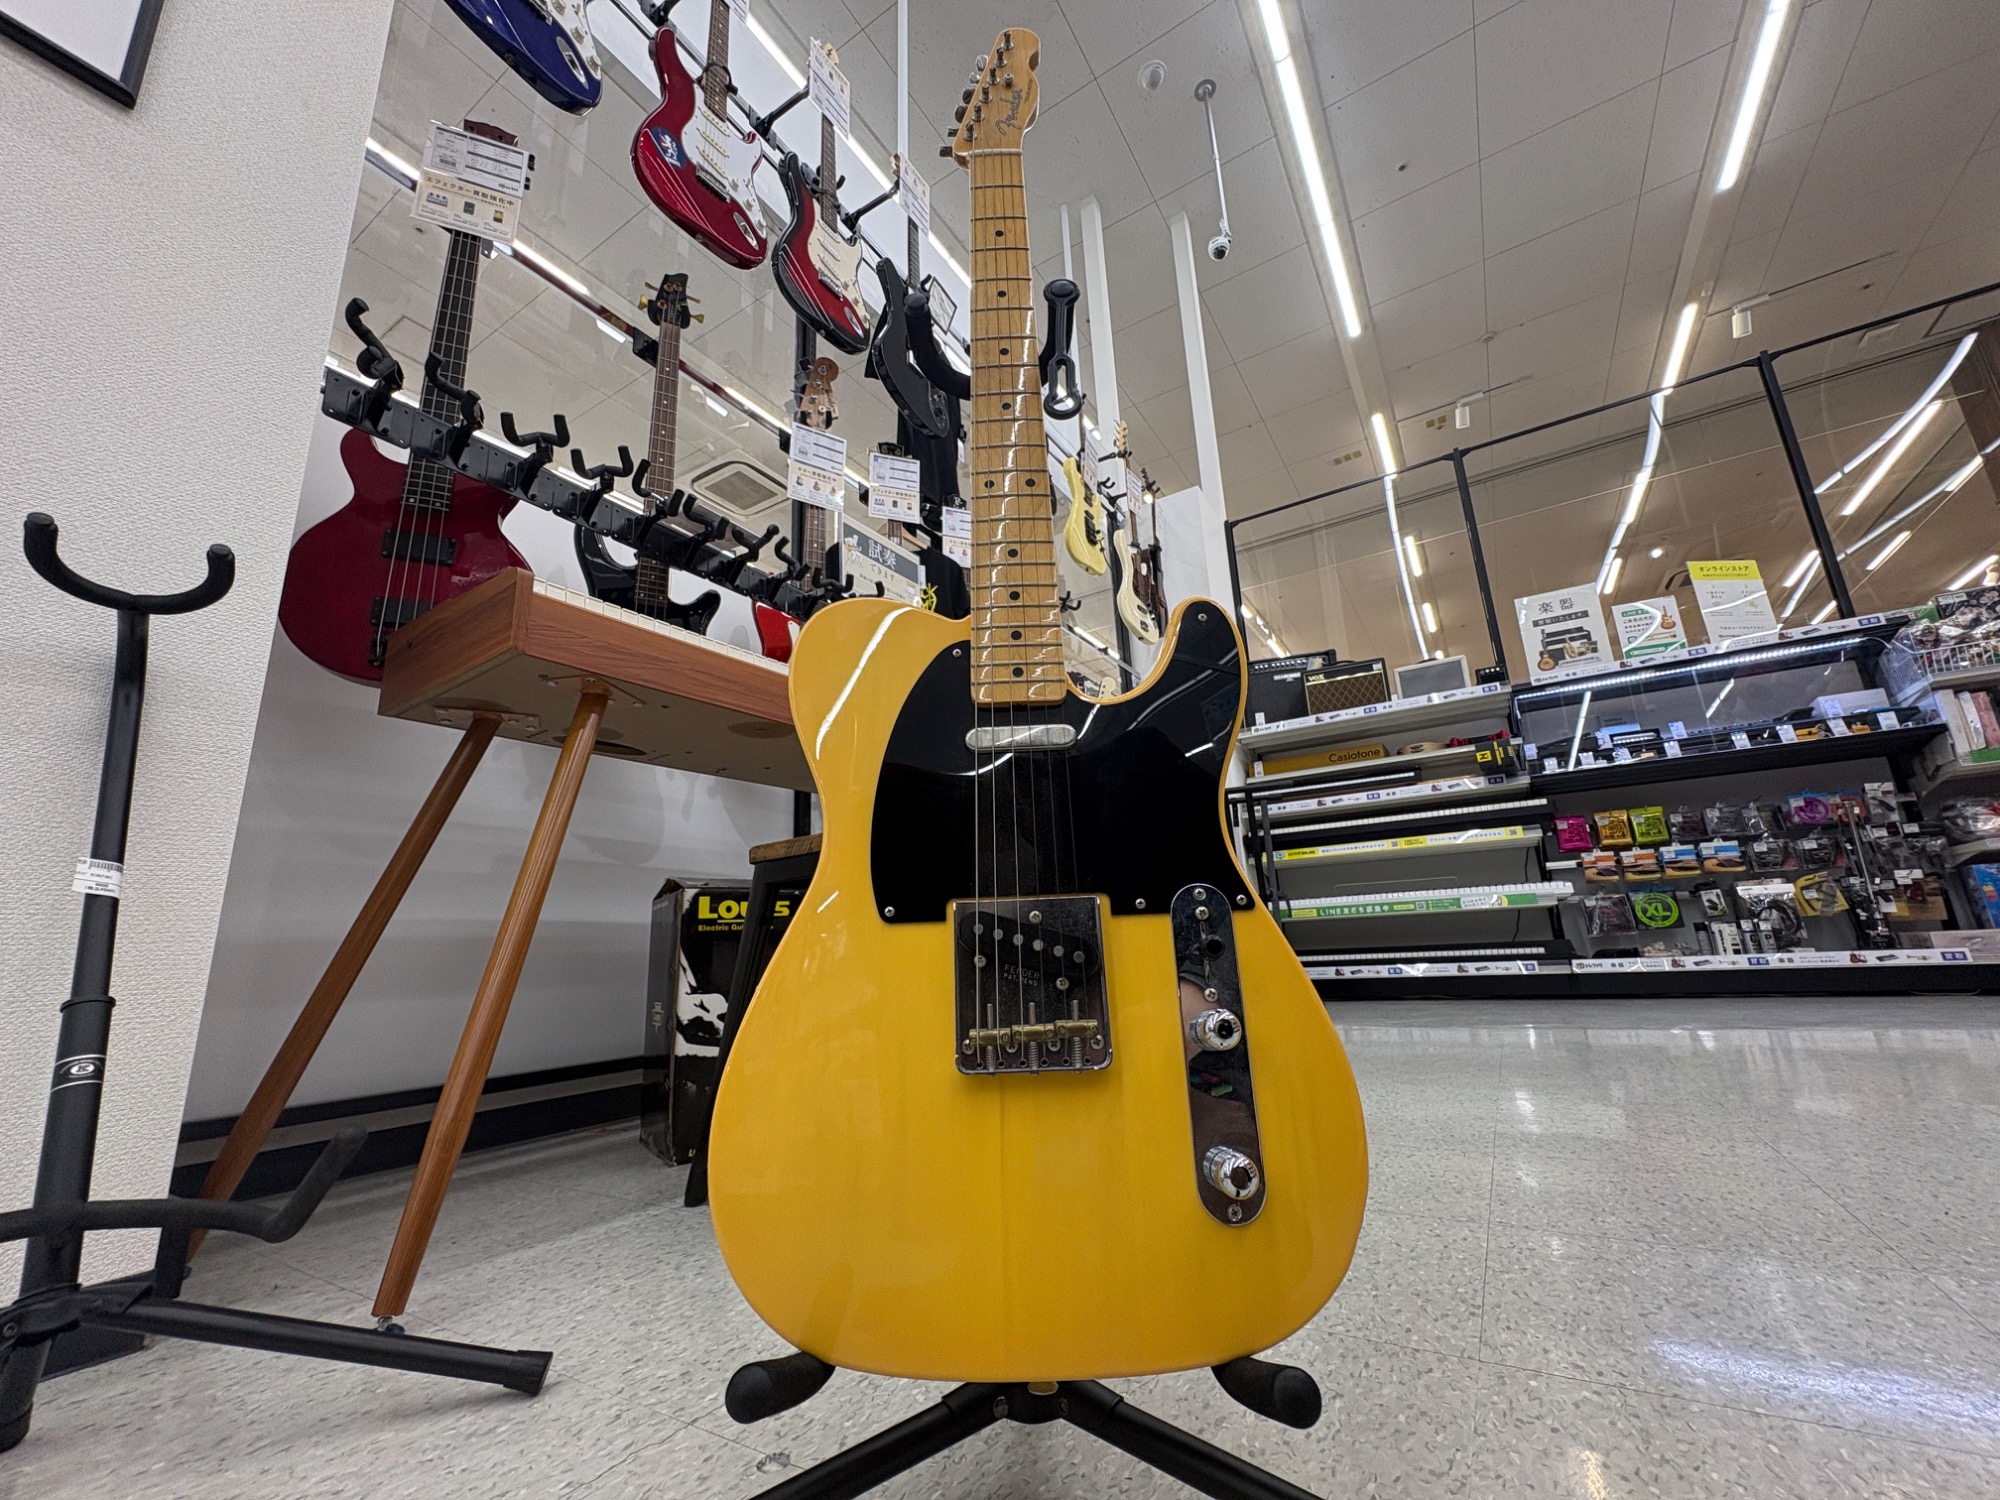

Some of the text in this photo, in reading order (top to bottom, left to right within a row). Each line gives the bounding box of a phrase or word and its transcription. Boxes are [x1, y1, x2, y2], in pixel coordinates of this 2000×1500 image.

[868, 539, 897, 570] 試奏
[870, 563, 895, 582] できます
[1308, 673, 1325, 681] VOX
[1328, 748, 1380, 763] Casiotone
[1643, 902, 1671, 918] XL
[1004, 964, 1040, 980] FENDER
